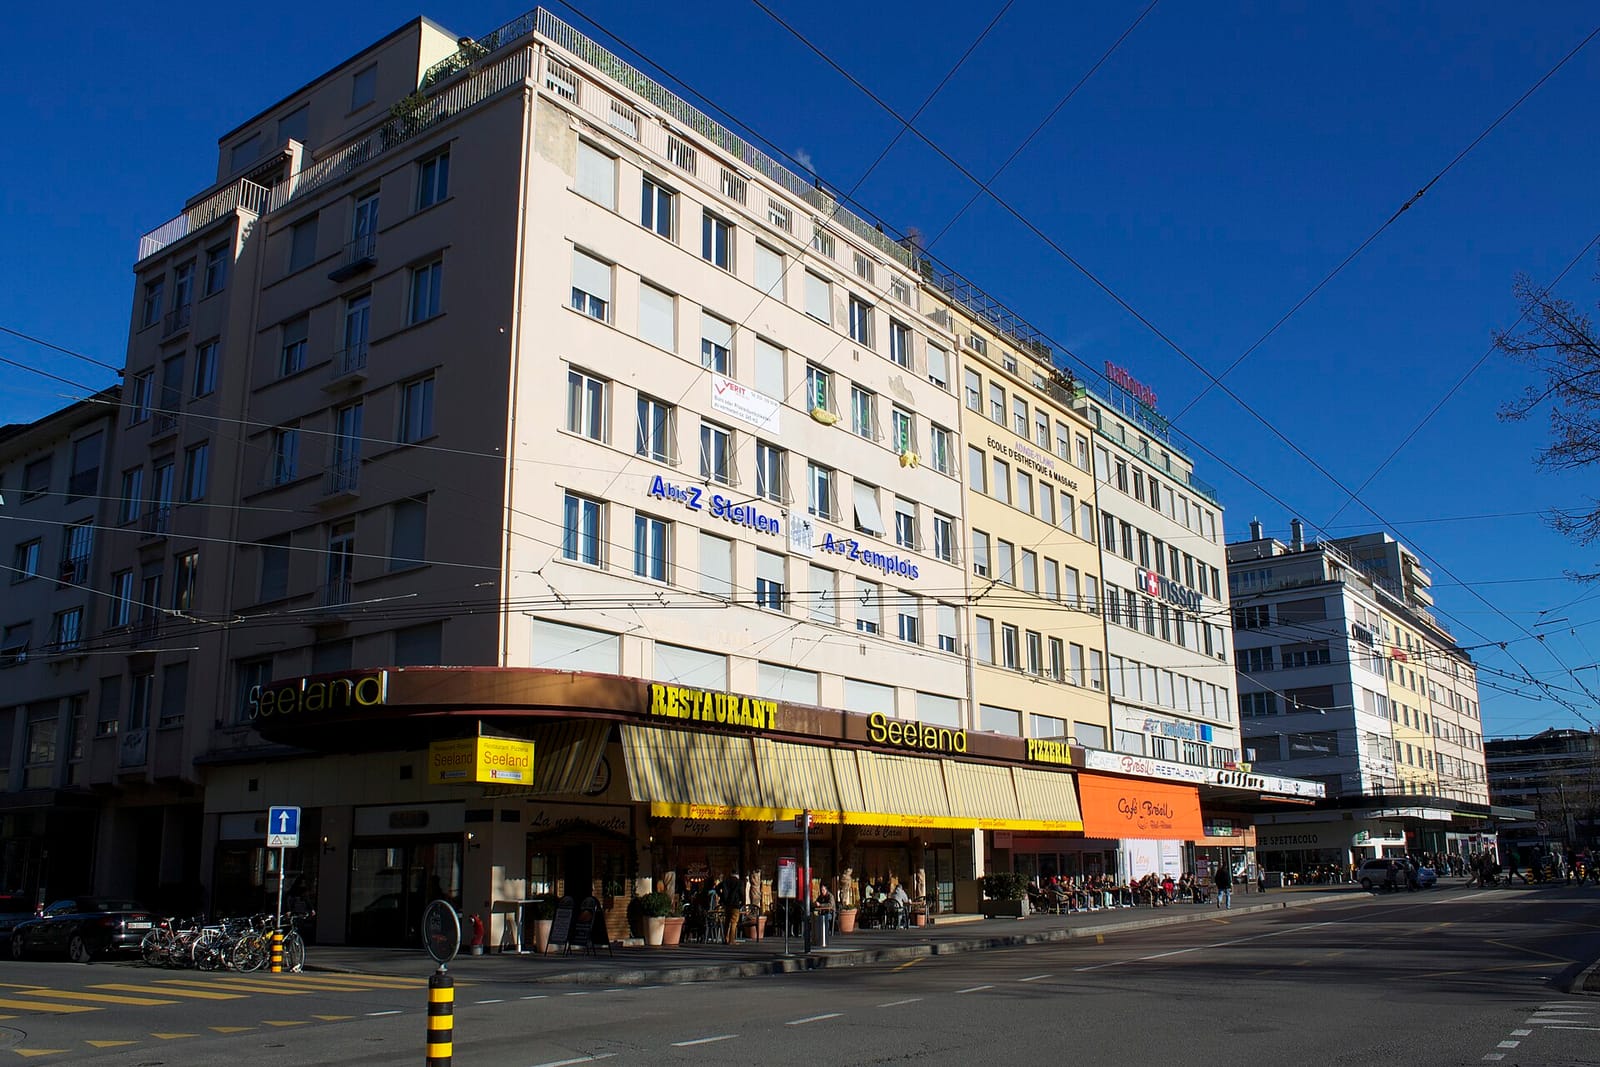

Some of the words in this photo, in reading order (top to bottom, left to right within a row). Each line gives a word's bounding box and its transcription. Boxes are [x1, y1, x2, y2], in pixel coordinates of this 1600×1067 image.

[987, 435, 1007, 455] ÉCOLE
[1053, 471, 1079, 491] MASSAGE
[650, 475, 665, 499] A
[666, 483, 688, 502] bis
[688, 486, 702, 510] Z
[711, 494, 779, 534] Stellen
[825, 532, 839, 552] A
[849, 540, 859, 559] Z
[863, 549, 919, 578] emplois
[1158, 576, 1202, 613] TISSOT
[249, 669, 388, 720] Seeland
[651, 683, 777, 730] RESTAURANT
[869, 711, 967, 753] Seeland
[434, 751, 473, 767] Seeland
[484, 751, 528, 768] Seeland
[1027, 738, 1072, 766] PIZZERIA
[1121, 756, 1154, 776] Brésil
[1155, 765, 1203, 780] RESTAURANT
[1217, 771, 1264, 788] Coiffure
[1118, 797, 1138, 820] Café
[1142, 799, 1174, 819] Brésil
[1270, 834, 1317, 845] SPETTACOLO
